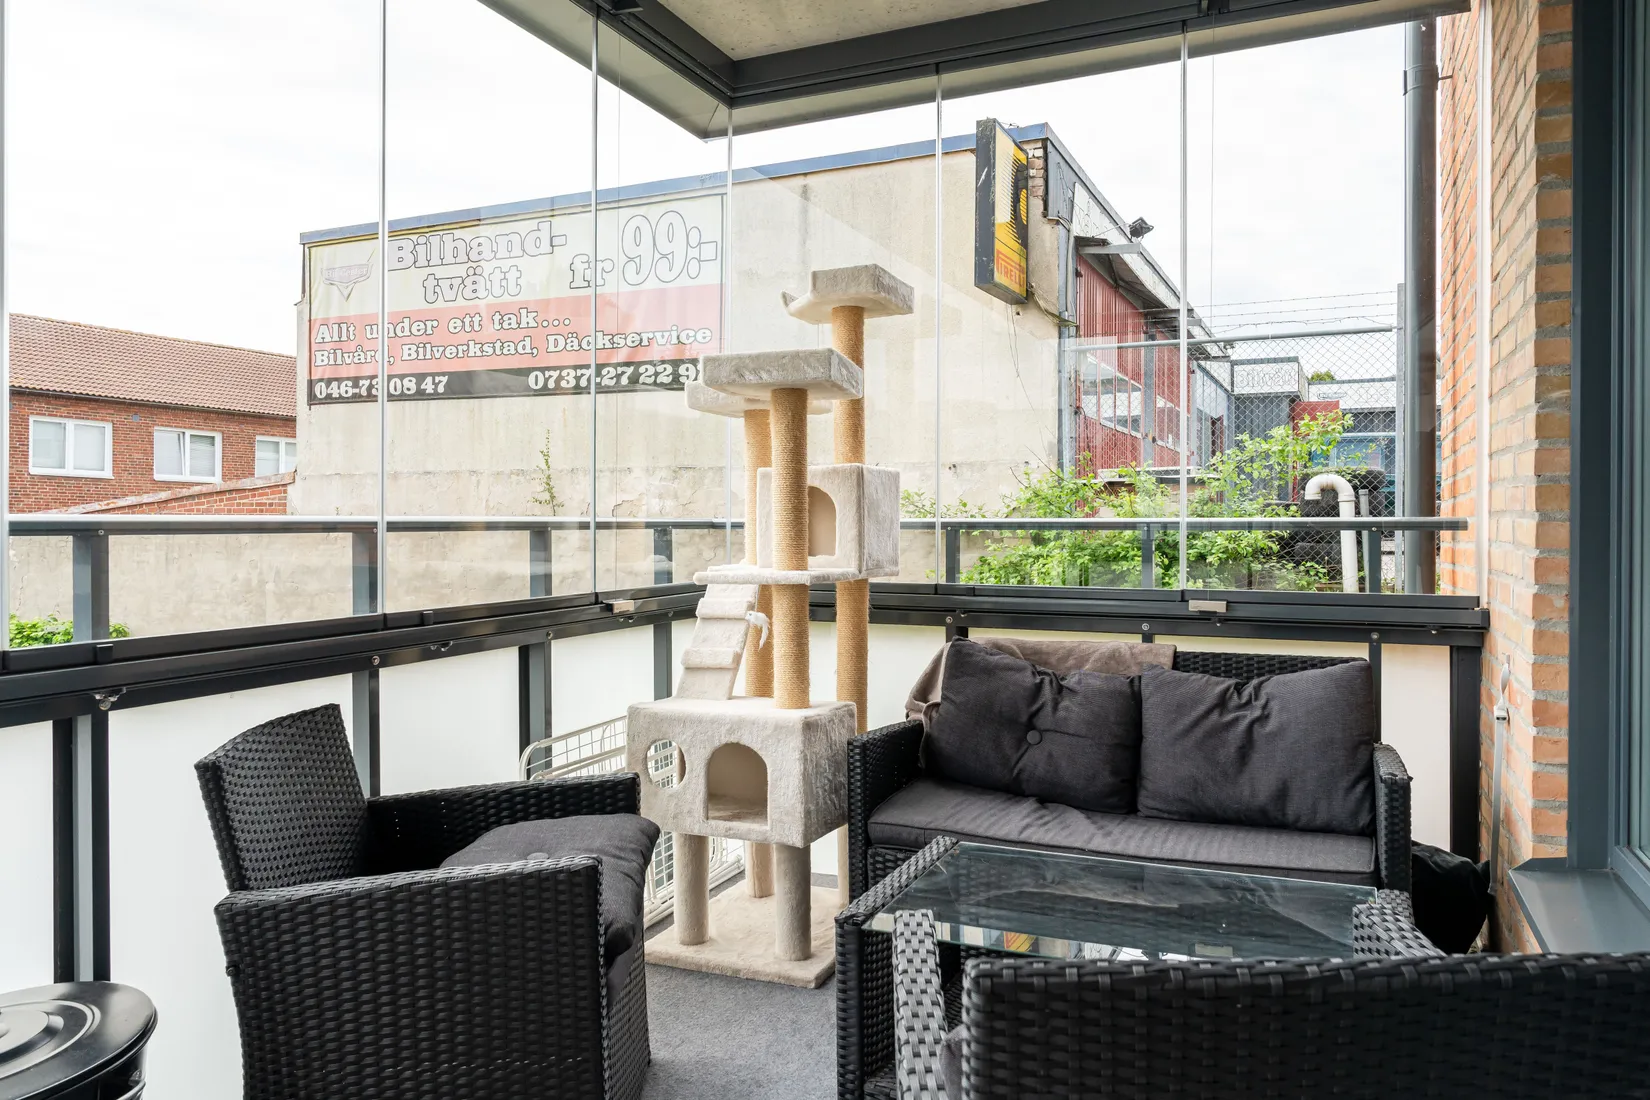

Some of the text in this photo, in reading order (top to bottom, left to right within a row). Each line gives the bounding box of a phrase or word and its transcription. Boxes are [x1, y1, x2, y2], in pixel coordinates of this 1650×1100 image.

[388, 221, 567, 271] Bilhand-
[570, 211, 717, 289] fr 99:-
[423, 265, 522, 303] tvätt
[996, 249, 1025, 288] PIRELLI
[315, 323, 356, 343] Allt
[448, 313, 482, 333] ett
[492, 308, 571, 331] tak...
[401, 336, 538, 360] Bilverkstad,
[546, 325, 712, 353] Däckservice
[389, 377, 417, 395] 08
[421, 375, 448, 393] 47
[638, 364, 673, 384] 22
[678, 363, 702, 382] 9
